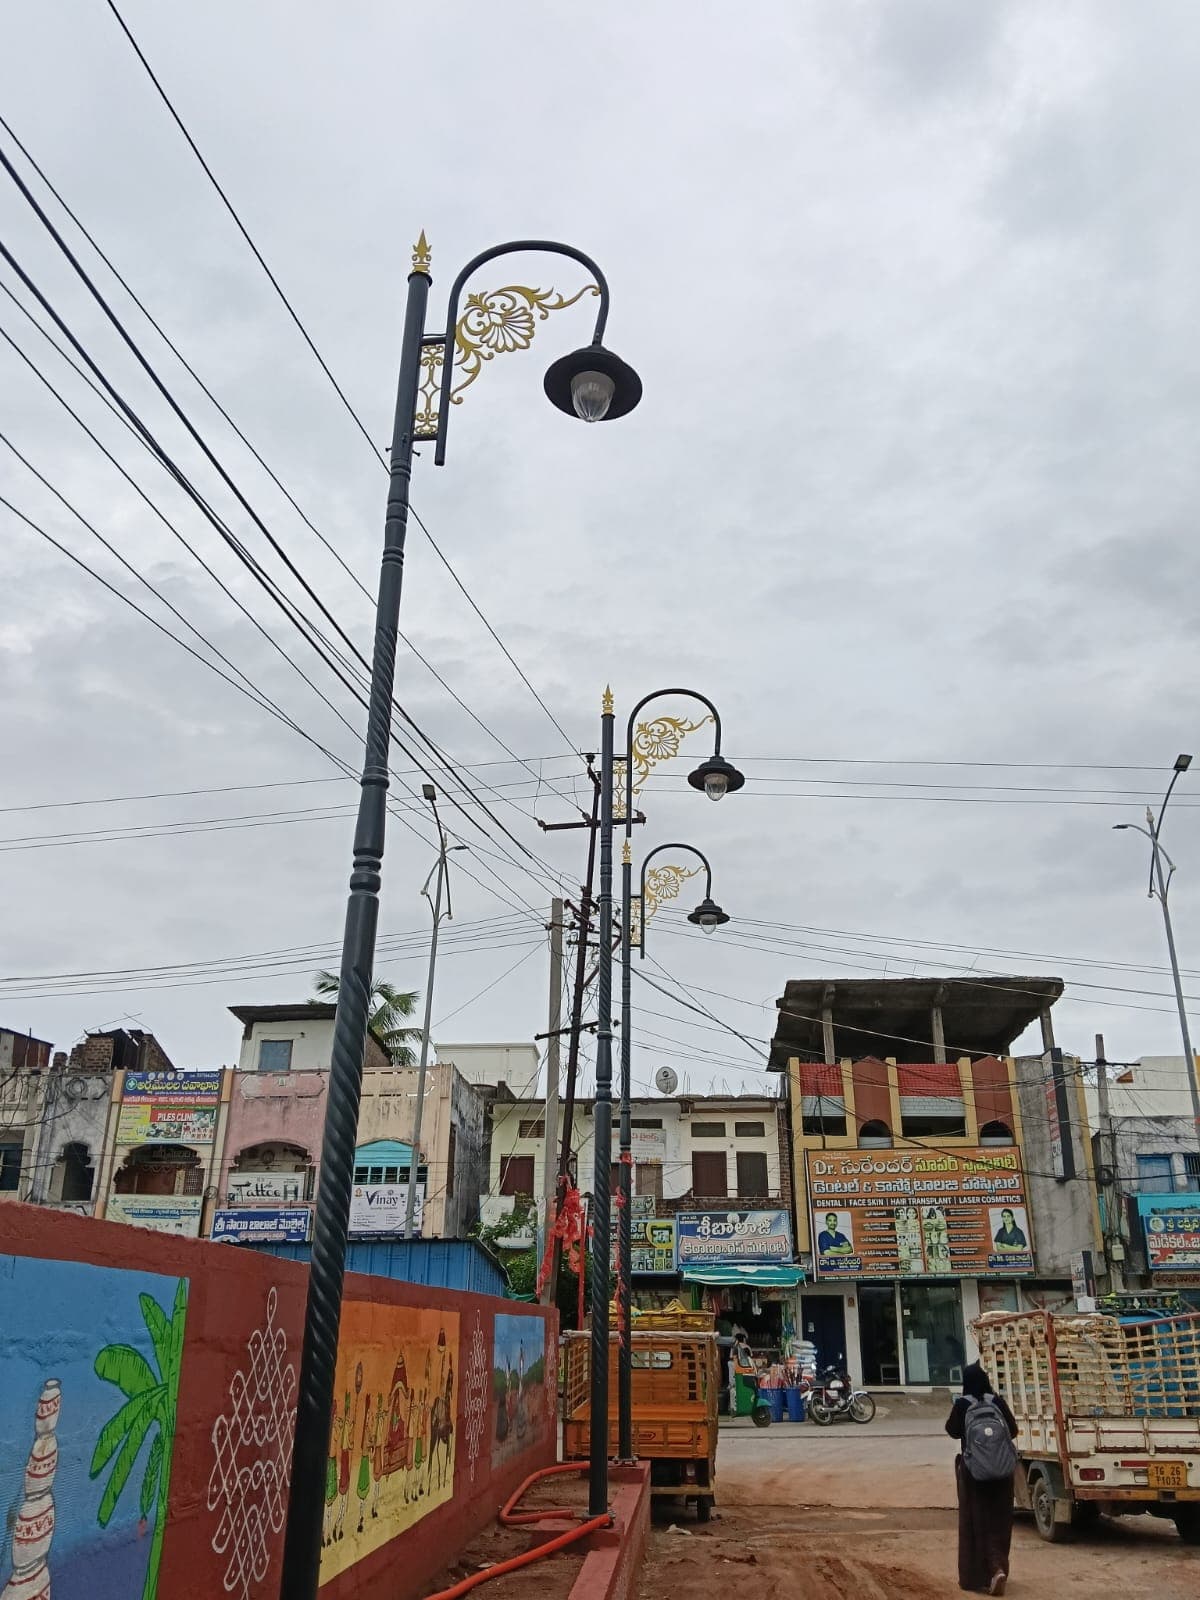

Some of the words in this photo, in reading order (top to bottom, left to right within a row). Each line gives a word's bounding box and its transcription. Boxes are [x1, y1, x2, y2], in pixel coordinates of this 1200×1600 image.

[157, 1112, 176, 1121] PILES
[813, 1159, 838, 1175] Dr.
[365, 1189, 398, 1207] Vinay
[816, 1199, 842, 1207] DENTAL
[849, 1198, 868, 1206] FACE
[868, 1198, 884, 1206] SKIN
[890, 1197, 907, 1205] HAIR
[908, 1197, 952, 1205] TRANSPLANT
[959, 1196, 981, 1204] LASER
[981, 1195, 1021, 1203] COSMETICS
[226, 1218, 248, 1230] సాయి
[1154, 1466, 1164, 1475] TG
[1170, 1466, 1181, 1475] 26
